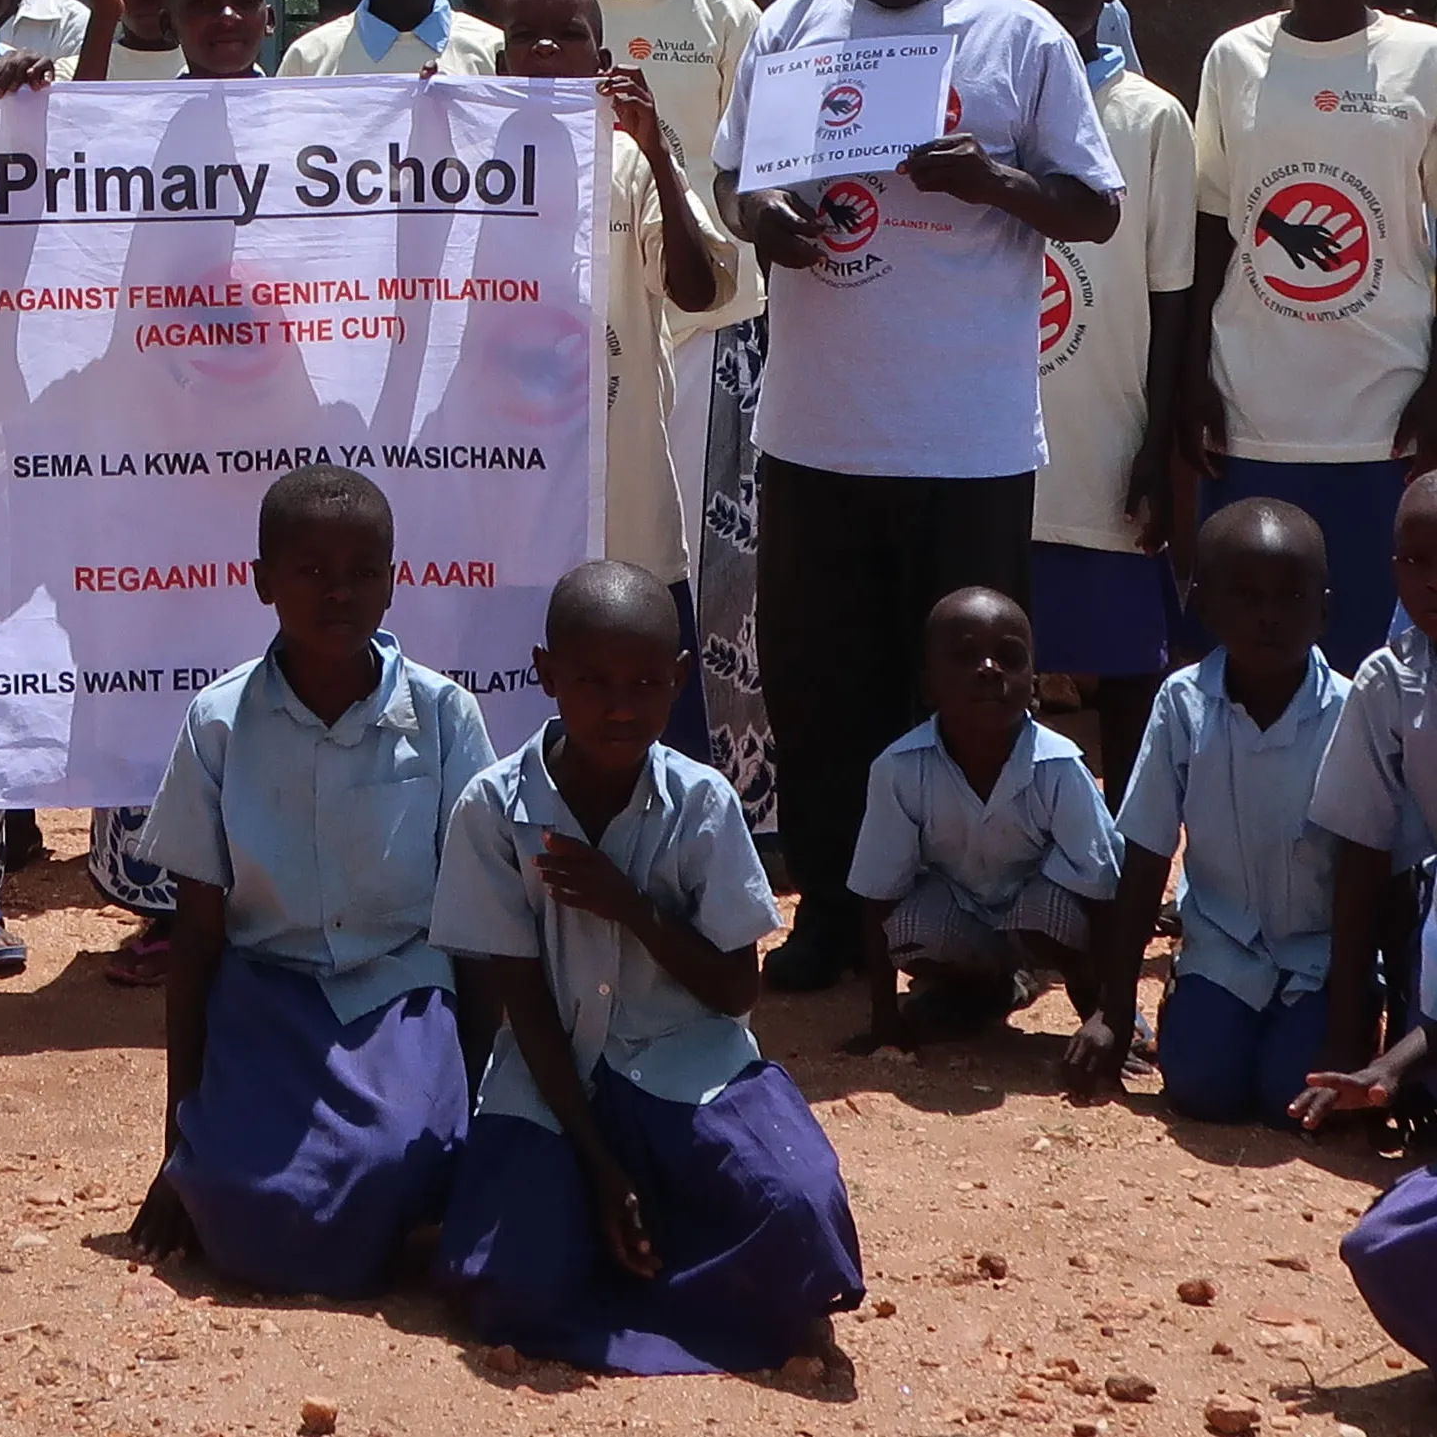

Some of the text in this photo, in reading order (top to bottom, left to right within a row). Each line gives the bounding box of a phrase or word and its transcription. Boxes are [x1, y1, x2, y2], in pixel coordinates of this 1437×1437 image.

[653, 38, 695, 52] Ayuda
[653, 51, 714, 64] en Acción
[767, 46, 938, 76] WE SAY NO TO FGM & CHILD
[815, 60, 879, 77] MARRIAGE
[295, 142, 536, 208] School
[755, 162, 773, 174] WE
[777, 157, 799, 170] SAY
[803, 152, 824, 165] YES
[828, 150, 844, 161] TO
[1318, 162, 1340, 178] THE
[883, 217, 928, 230] AGAINST
[128, 284, 243, 310] FEMALE
[251, 280, 370, 306] GENITAL
[377, 277, 540, 303] MUTILATION
[135, 315, 406, 352] (AGAINST THE CUT)
[13, 453, 92, 478] SEMA
[100, 453, 137, 477] LA
[145, 453, 211, 476] KWA
[339, 445, 377, 469] YA
[381, 445, 547, 471] WASICHANA
[74, 563, 217, 592] REGAANI
[421, 561, 495, 588] AARI
[83, 669, 164, 694] WANT
